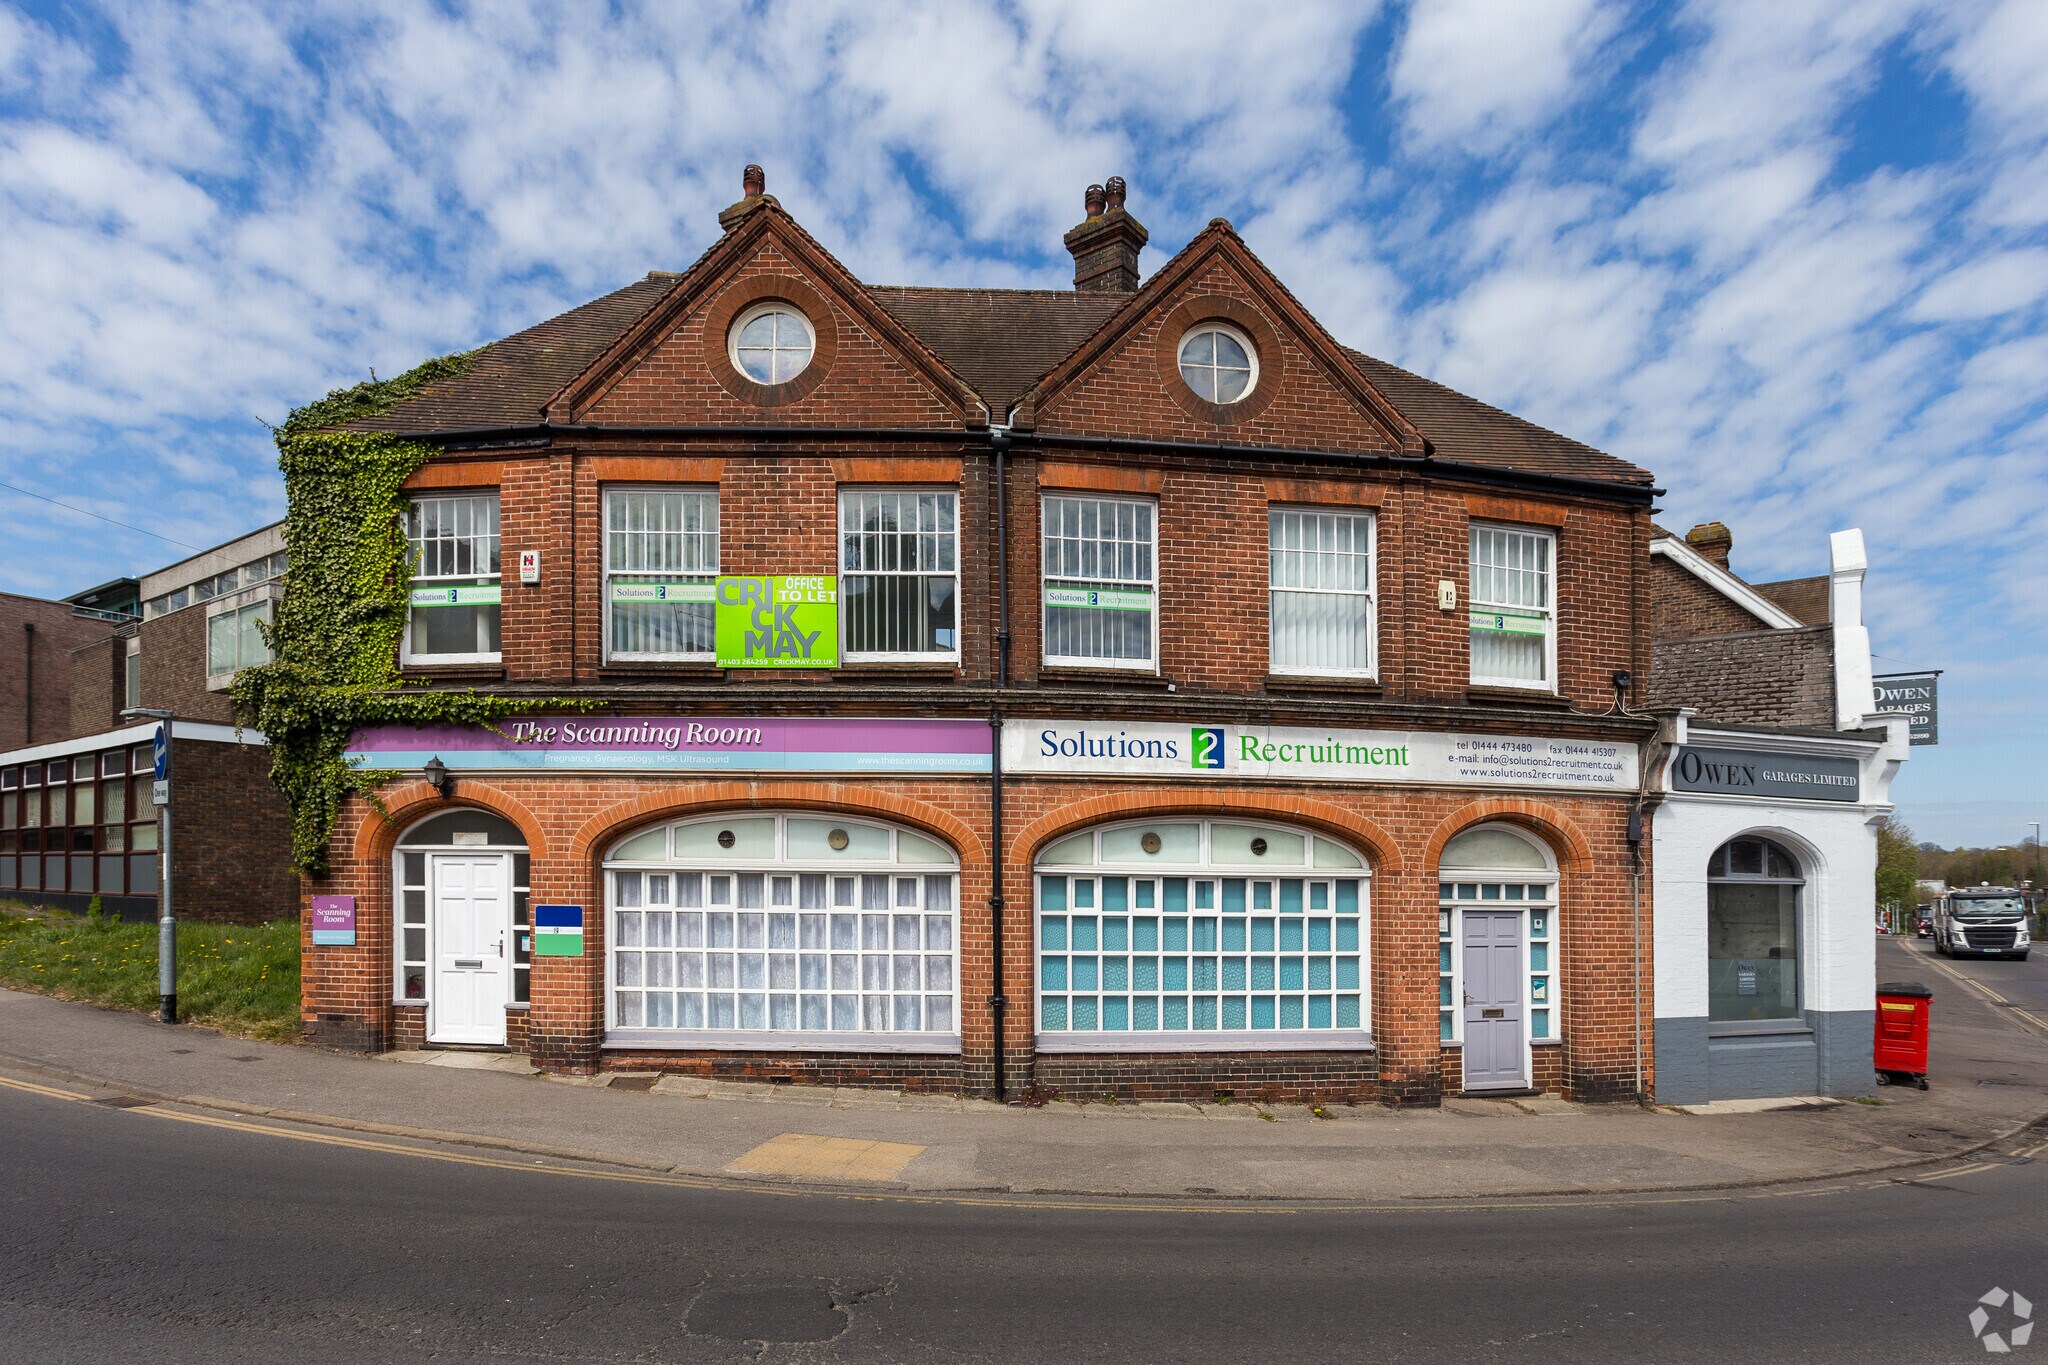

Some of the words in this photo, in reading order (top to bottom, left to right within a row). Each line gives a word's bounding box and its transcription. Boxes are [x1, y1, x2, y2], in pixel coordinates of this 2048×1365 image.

[785, 577, 824, 590] OFFICE
[413, 592, 447, 602] Solutions
[449, 590, 457, 602] 2
[616, 588, 654, 597] Solutions
[656, 587, 665, 599] 2
[717, 578, 773, 606] CRI
[779, 590, 802, 602] TO
[807, 590, 837, 602] LET
[1049, 592, 1086, 602] Solutions
[1088, 592, 1097, 605] 2
[1100, 596, 1147, 606] Recruitment
[1469, 616, 1494, 626] olutions
[1496, 617, 1503, 628] 2
[1505, 620, 1542, 630] Recruitment
[744, 631, 822, 658] MAY
[1878, 703, 1931, 712] ARAGES
[512, 721, 558, 744] The
[561, 721, 681, 749] Scanning
[686, 722, 762, 745] Room
[1040, 730, 1178, 759] Solutions
[1197, 731, 1220, 765] 2
[1238, 735, 1410, 767] Recruitment
[1456, 741, 1469, 750] tel
[1471, 741, 1498, 751] 01444
[1500, 742, 1533, 753] 473480
[1549, 745, 1563, 755] fax
[1565, 745, 1589, 756] 01444
[1591, 747, 1617, 757] 415307
[544, 754, 593, 764] Pregnancy,
[596, 754, 655, 765] Gynaecology,
[657, 754, 677, 763] MSK
[680, 754, 730, 764] Ultrasound
[856, 757, 984, 767] www.thescanningroom.co.uk
[1448, 753, 1480, 763] e-mail:
[1482, 754, 1624, 771] info@solutions2recruitment.co.uk
[1459, 767, 1615, 783] www.solutions2recruitment.co.uk
[1762, 770, 1811, 784] GARAGES
[1813, 774, 1857, 787] LIMITED
[316, 908, 351, 917] Scanning
